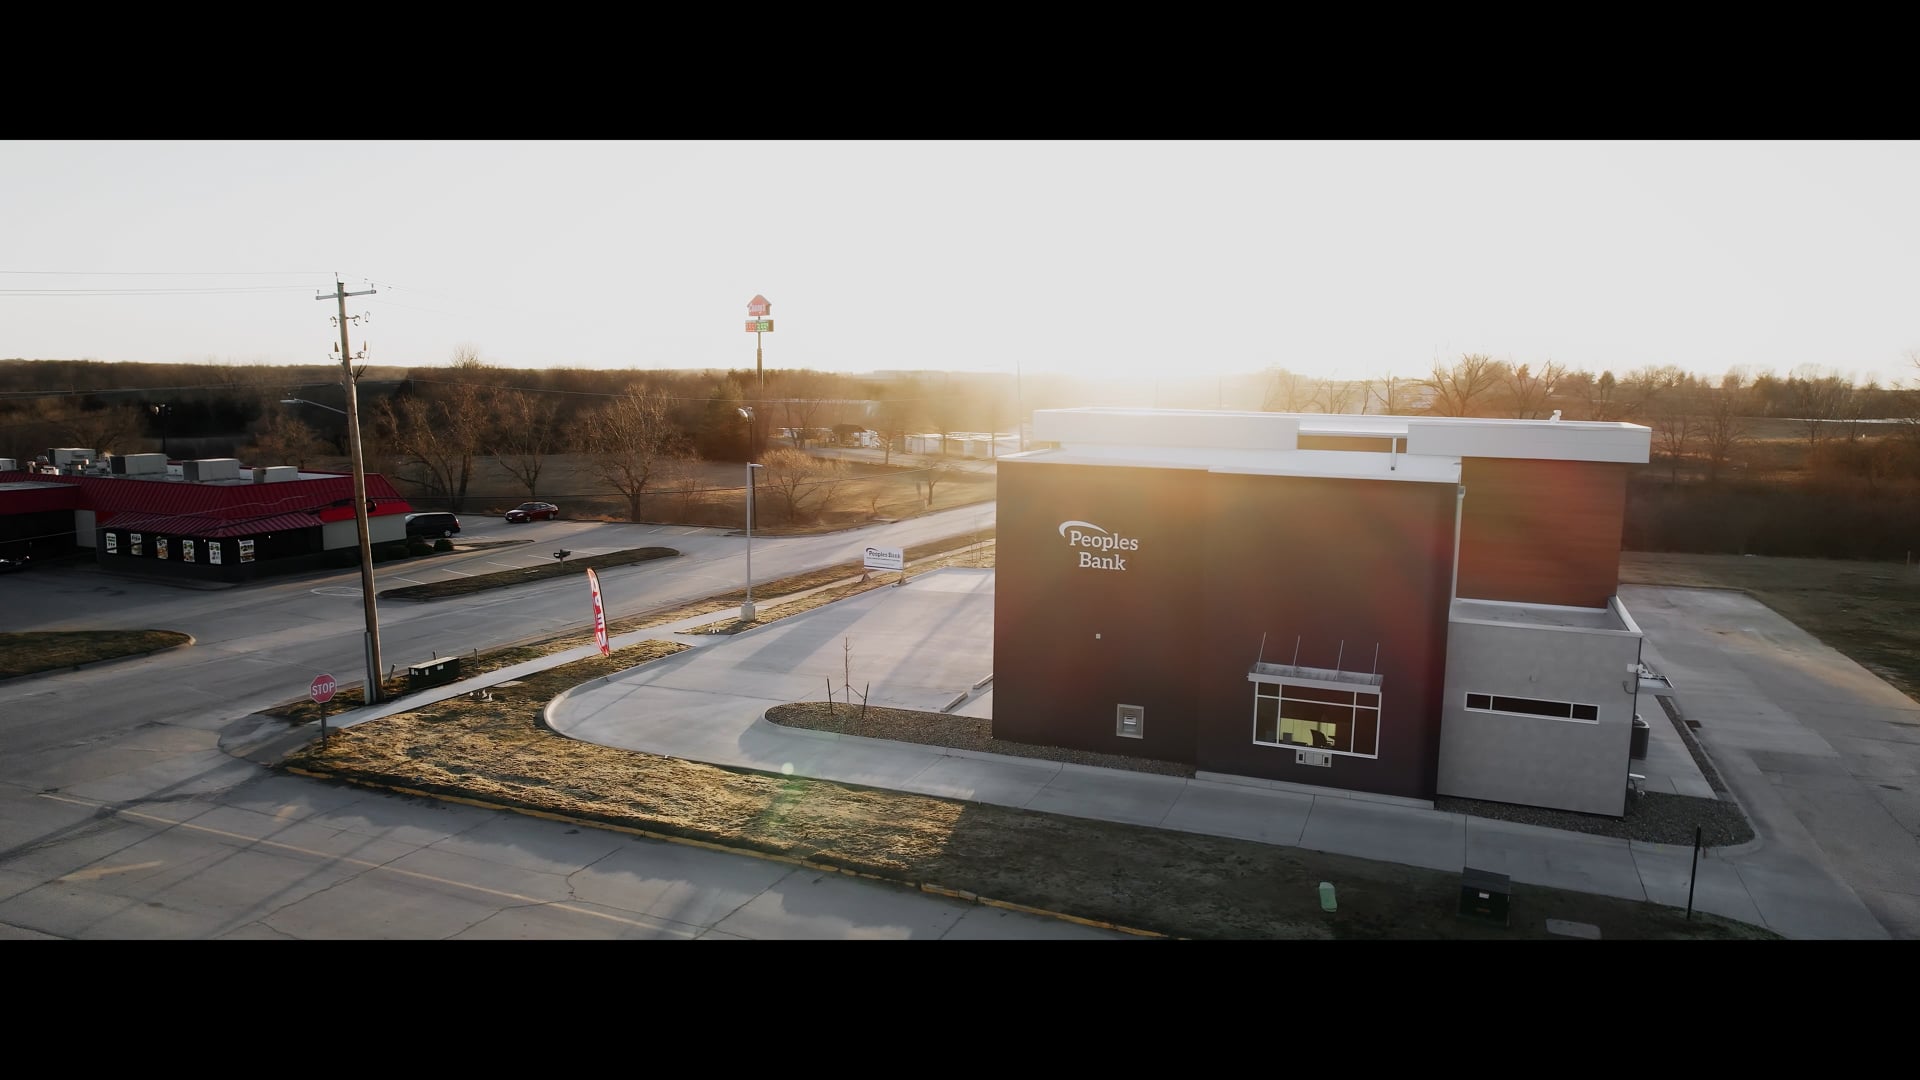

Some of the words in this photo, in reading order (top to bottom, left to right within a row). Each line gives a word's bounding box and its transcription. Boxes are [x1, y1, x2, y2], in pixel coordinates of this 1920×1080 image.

[1069, 530, 1139, 551] Peoples
[1079, 551, 1126, 571] Bank
[312, 681, 335, 696] STOP
